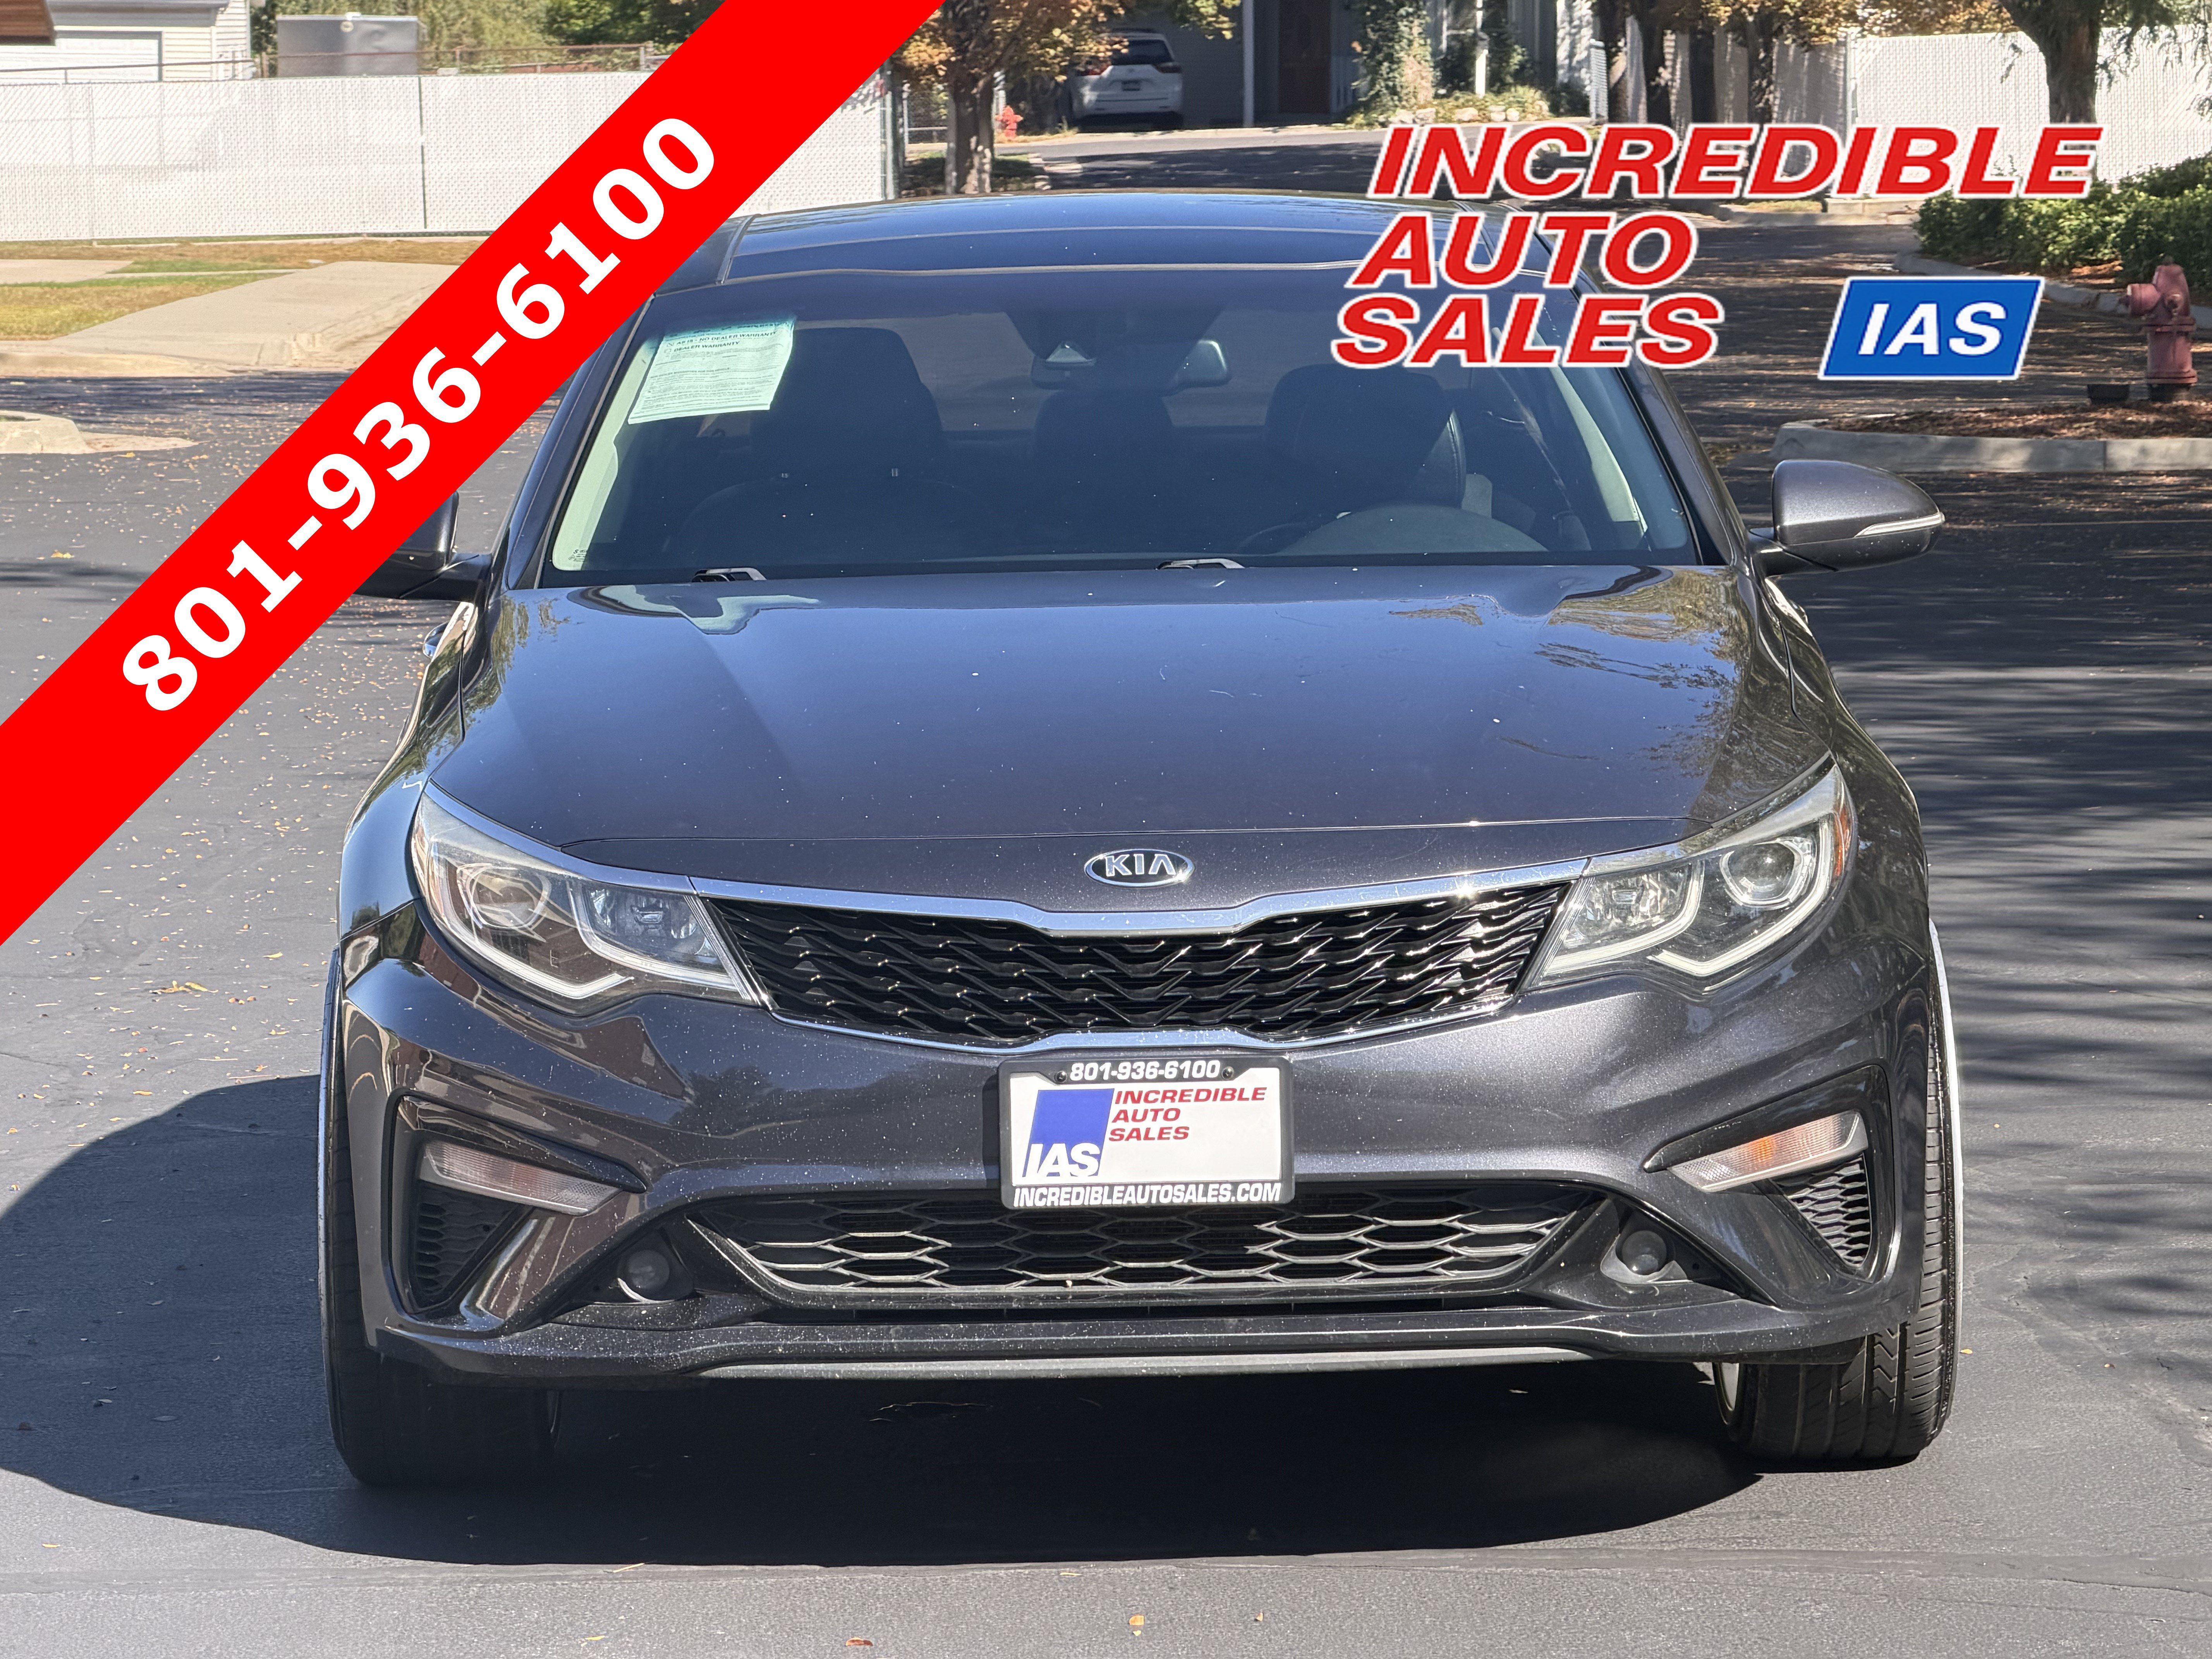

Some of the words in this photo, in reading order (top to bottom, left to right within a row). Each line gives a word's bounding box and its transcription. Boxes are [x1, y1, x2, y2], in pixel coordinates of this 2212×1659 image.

[1104, 854, 1176, 877] KIA
[1070, 1060, 1221, 1081] 801-936-6100
[1115, 1087, 1266, 1104] INCREDIBLE
[1113, 1108, 1180, 1123] AUTO
[1109, 1127, 1189, 1141] SALES
[1026, 1142, 1100, 1177] IAS
[1013, 1182, 1281, 1207] INCREDIBLEAUTOSALES.COM
